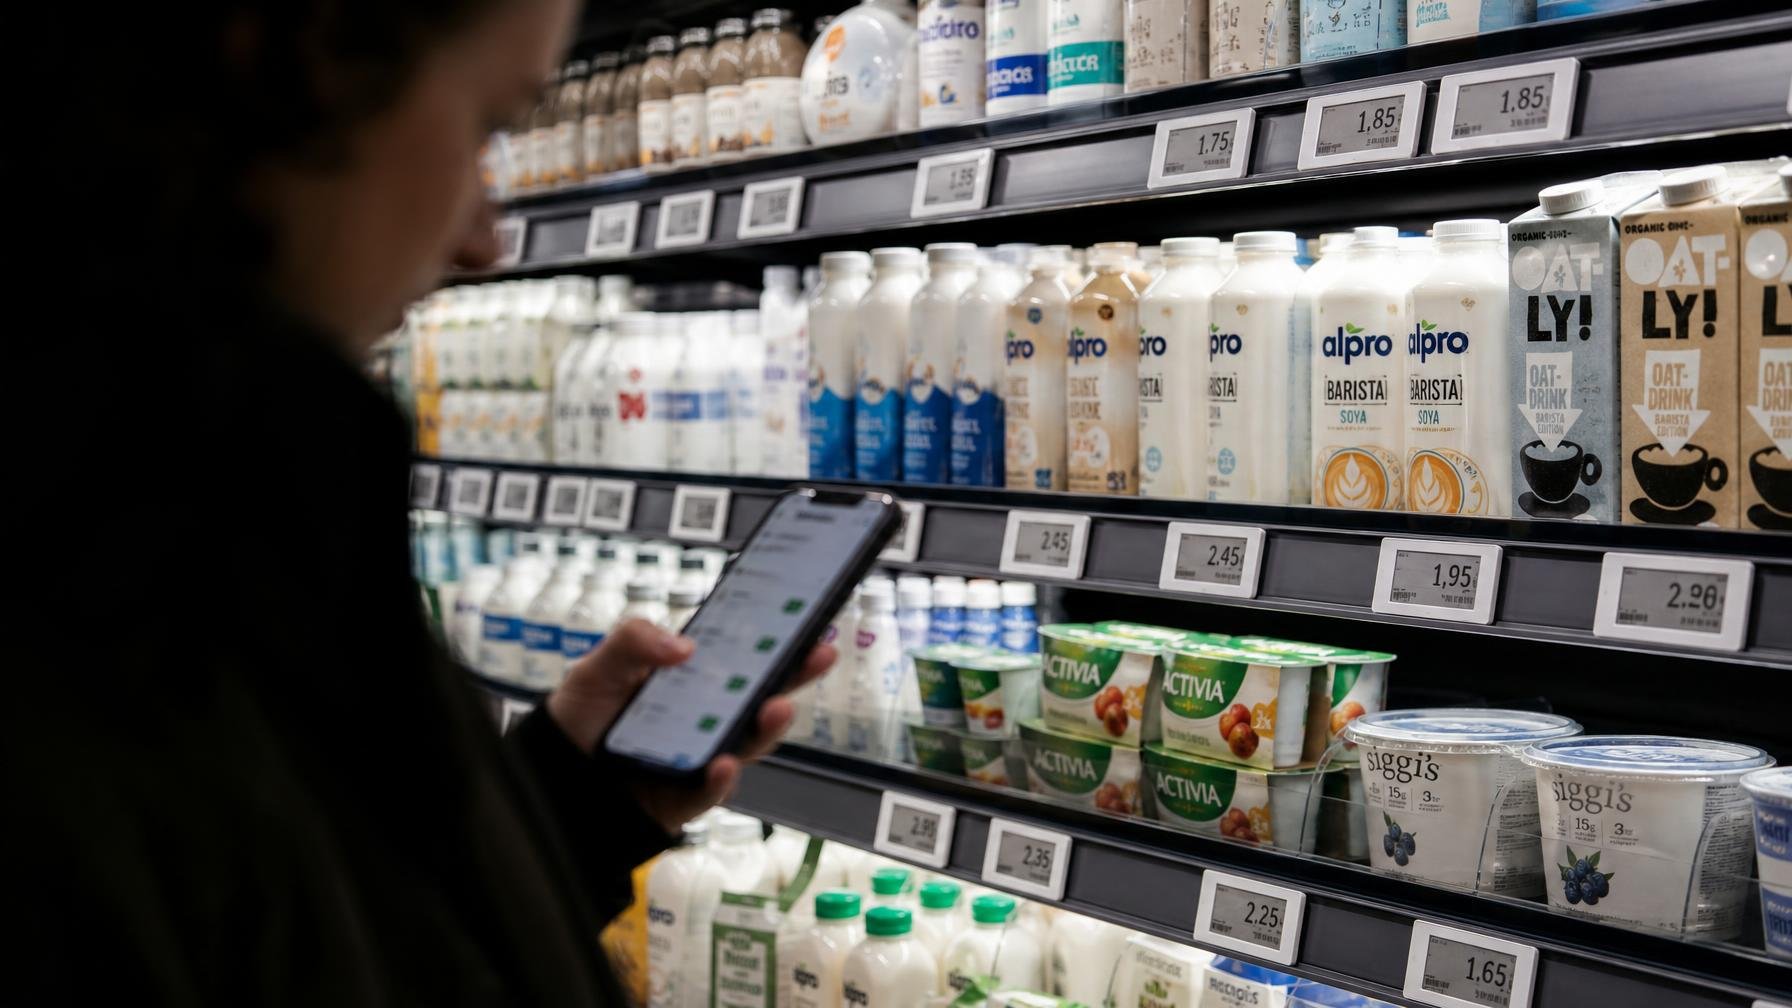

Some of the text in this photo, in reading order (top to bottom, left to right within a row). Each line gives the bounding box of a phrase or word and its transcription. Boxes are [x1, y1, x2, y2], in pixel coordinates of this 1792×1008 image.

[1500, 86, 1545, 113] 1.85
[1357, 107, 1396, 134] 1.85
[1198, 131, 1230, 156] 1.75
[1527, 294, 1592, 342] LY!
[1642, 289, 1717, 339] LY!
[1323, 326, 1393, 365] alpro
[1409, 323, 1469, 363] alpro
[1327, 380, 1384, 400] BARISTA
[1529, 388, 1567, 410] DRINK
[1648, 388, 1695, 411] DRINK
[1340, 410, 1367, 424] SOYA
[1418, 409, 1440, 425] SOYA
[1041, 531, 1068, 551] 2.45
[1207, 545, 1240, 566] 2.45
[1162, 671, 1224, 703] ACTIVIA
[1366, 746, 1440, 783] siggi's
[1156, 771, 1222, 807] ACTIVIA
[1244, 901, 1278, 928] 2.25
[1465, 956, 1507, 987] 1.65
